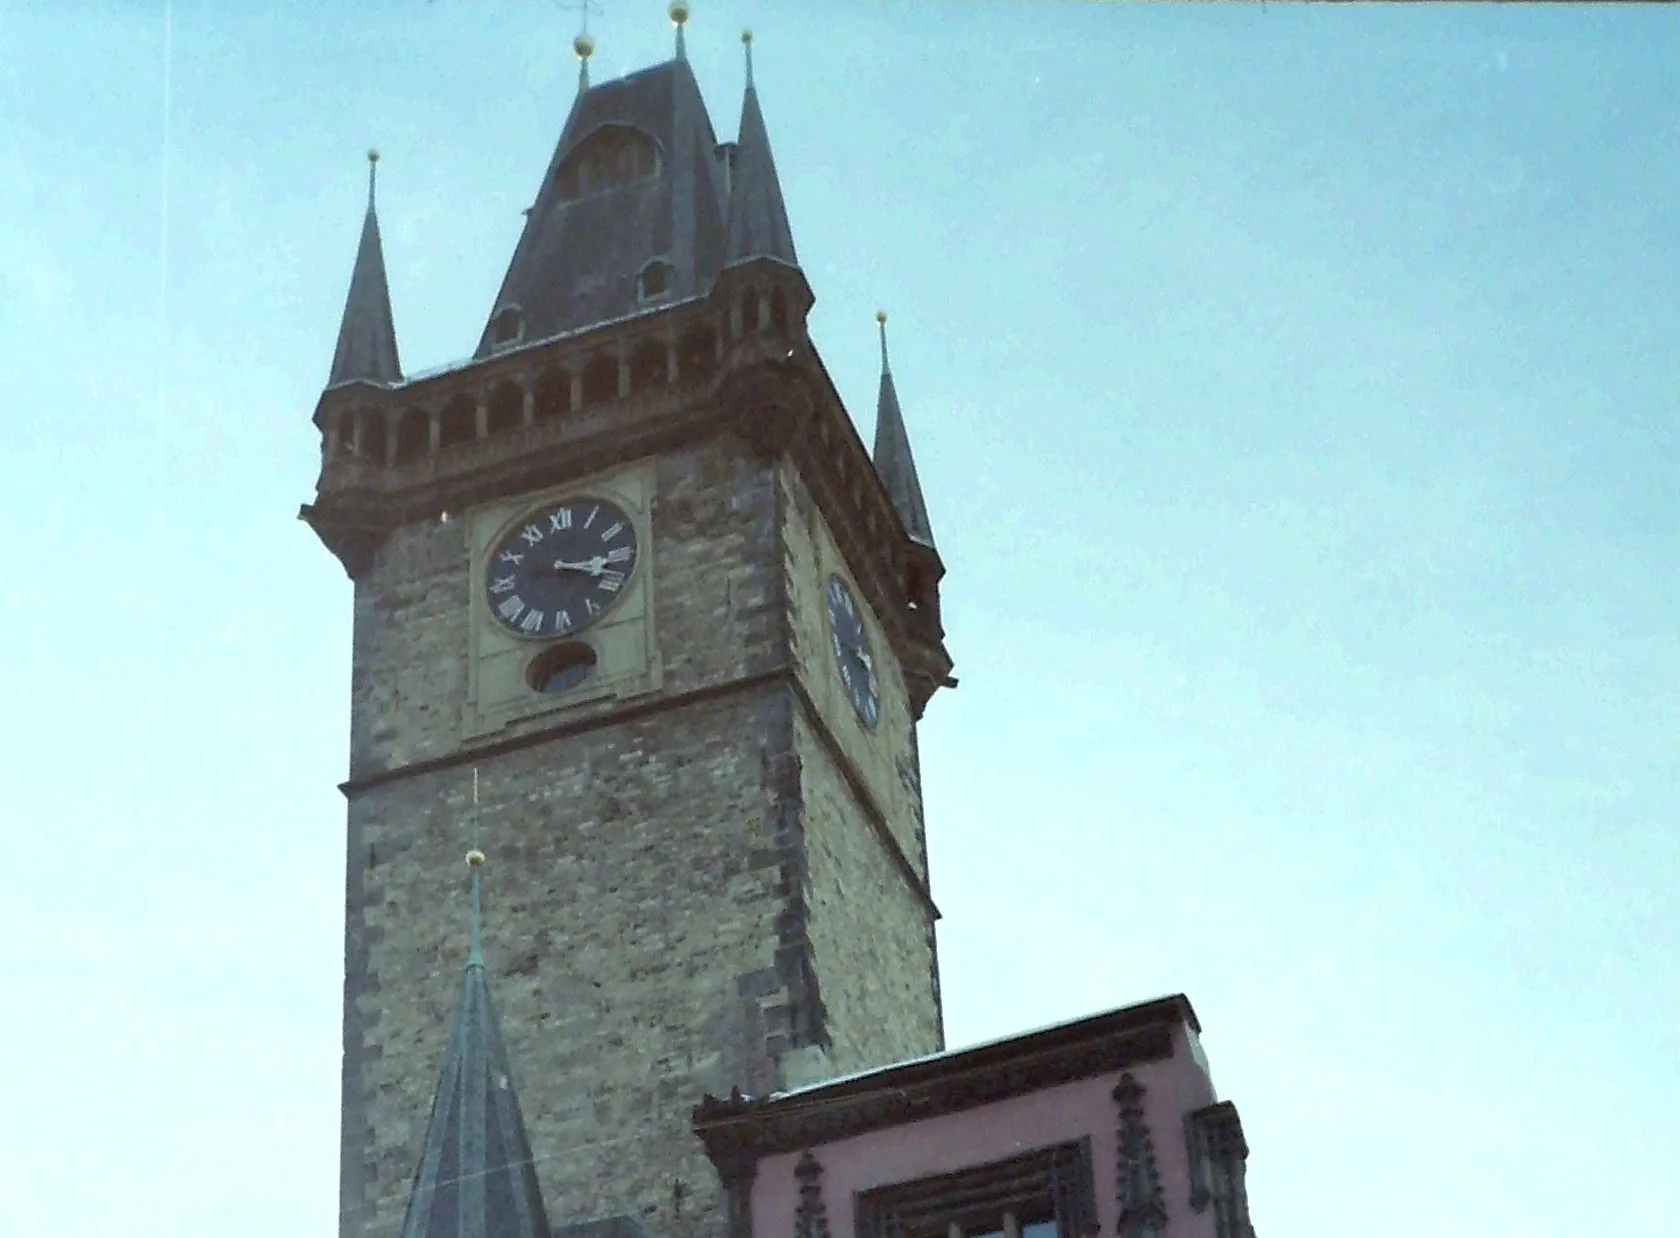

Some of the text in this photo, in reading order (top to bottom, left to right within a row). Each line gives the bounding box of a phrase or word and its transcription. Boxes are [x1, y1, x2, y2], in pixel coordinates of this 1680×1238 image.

[550, 507, 572, 534] XII
[583, 505, 599, 529] I
[500, 550, 525, 565] X
